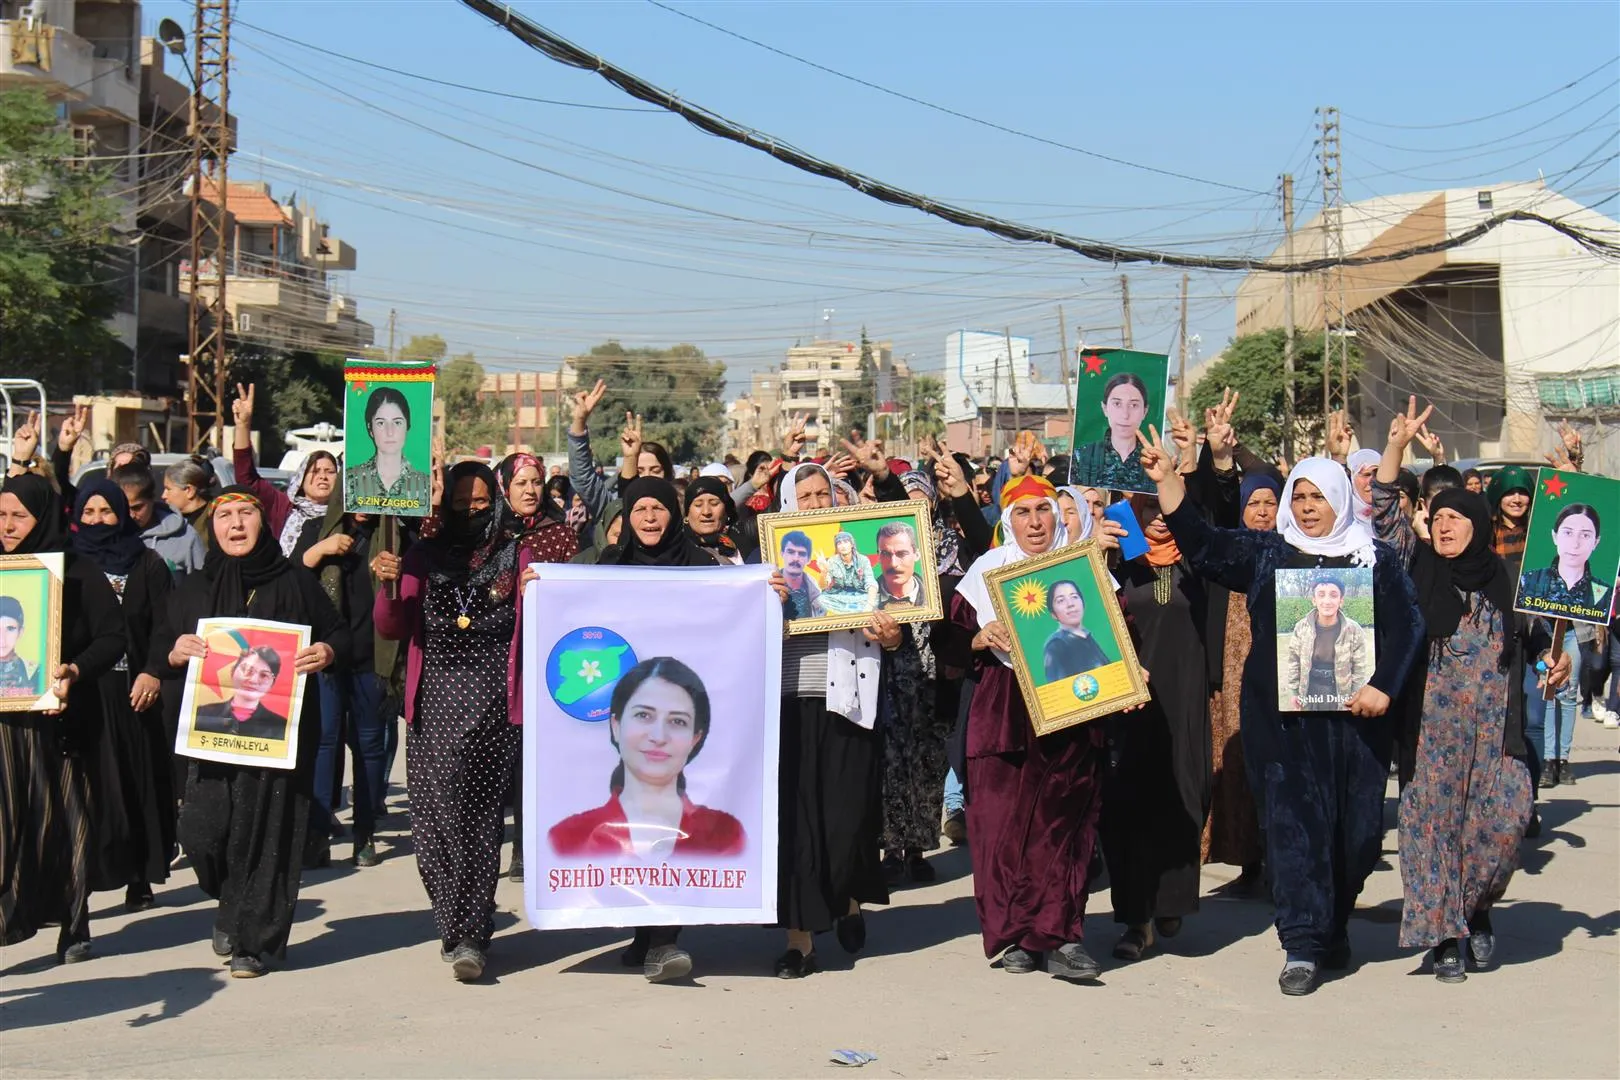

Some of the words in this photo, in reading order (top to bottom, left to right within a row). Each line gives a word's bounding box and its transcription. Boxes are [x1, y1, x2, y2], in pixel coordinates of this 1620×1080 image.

[381, 498, 420, 508] ZAGROS
[548, 863, 605, 892] ŞEHÎD
[609, 862, 682, 887] HEVRÎN
[686, 868, 747, 889] XELEF
